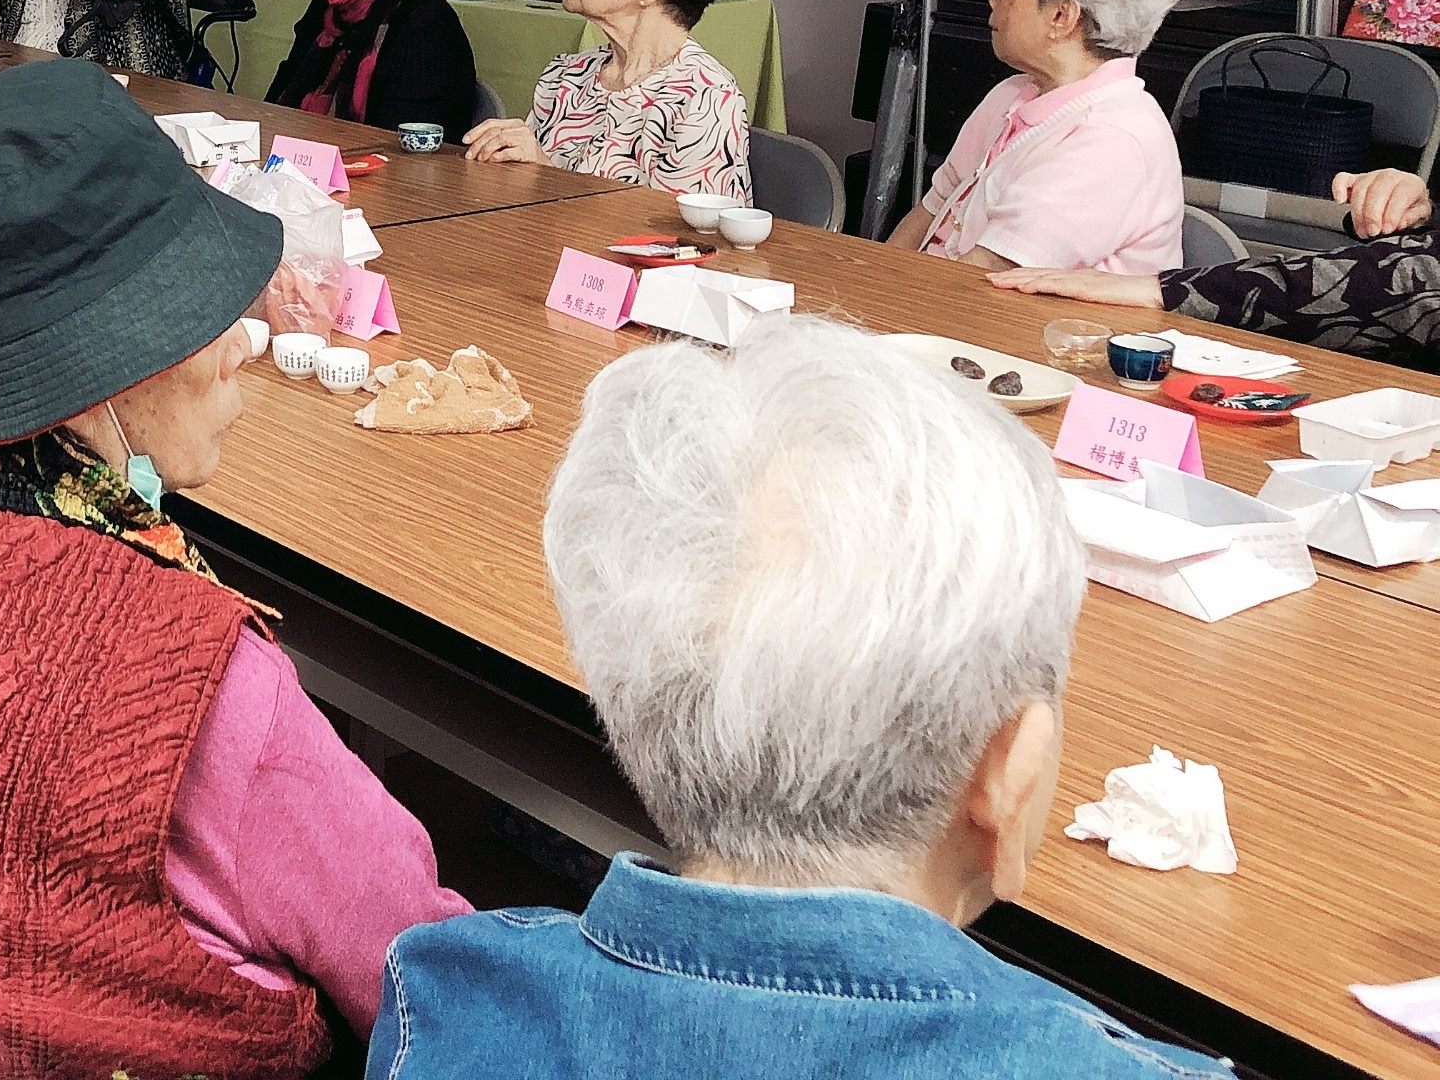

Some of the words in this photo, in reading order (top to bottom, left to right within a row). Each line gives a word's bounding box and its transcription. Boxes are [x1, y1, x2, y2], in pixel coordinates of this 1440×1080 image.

[293, 153, 313, 167] 1321
[581, 273, 605, 292] 1308
[1107, 416, 1148, 442] 1313
